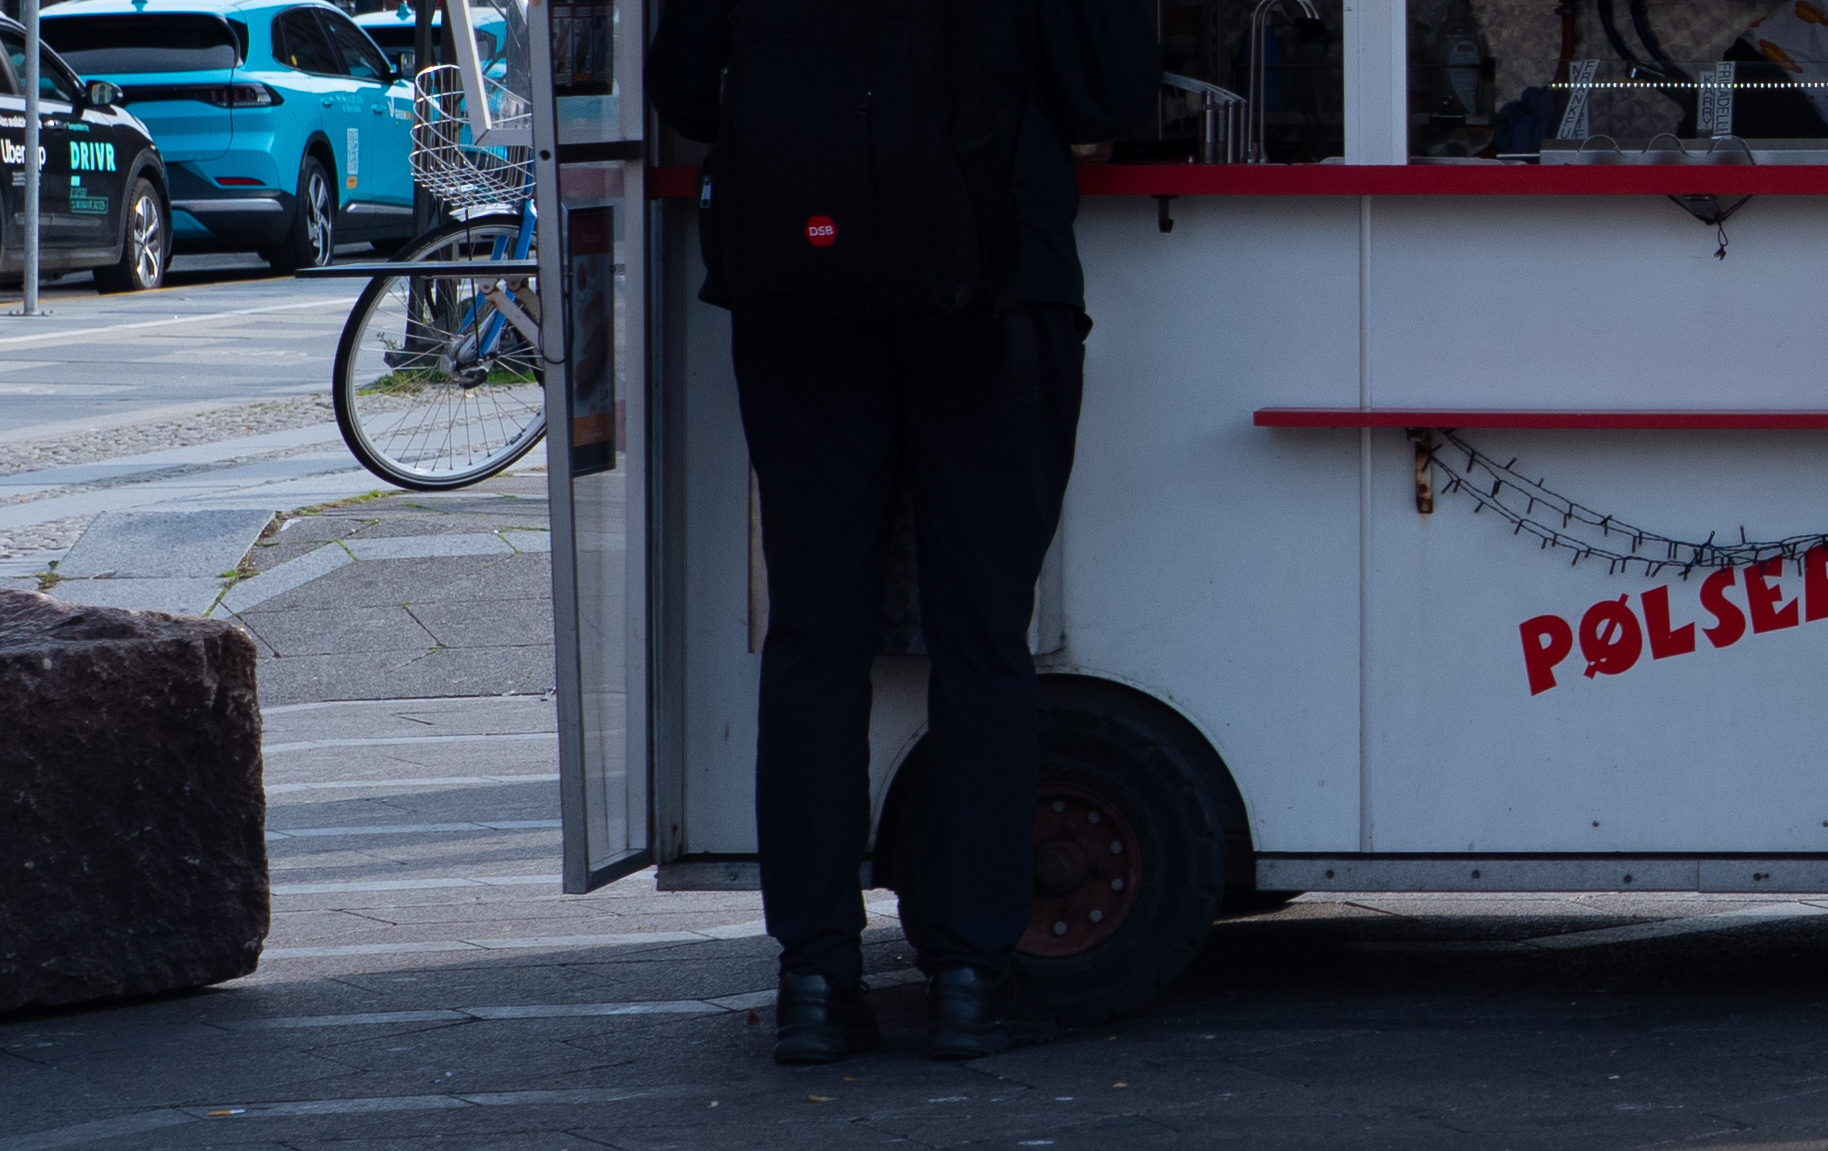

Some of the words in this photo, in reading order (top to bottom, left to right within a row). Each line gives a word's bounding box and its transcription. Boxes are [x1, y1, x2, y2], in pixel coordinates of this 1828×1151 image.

[1701, 74, 1713, 129] KARRY
[1717, 62, 1732, 132] FRIADELL
[0, 138, 26, 164] Uber
[69, 141, 117, 172] DRIVR
[808, 225, 835, 237] DSB
